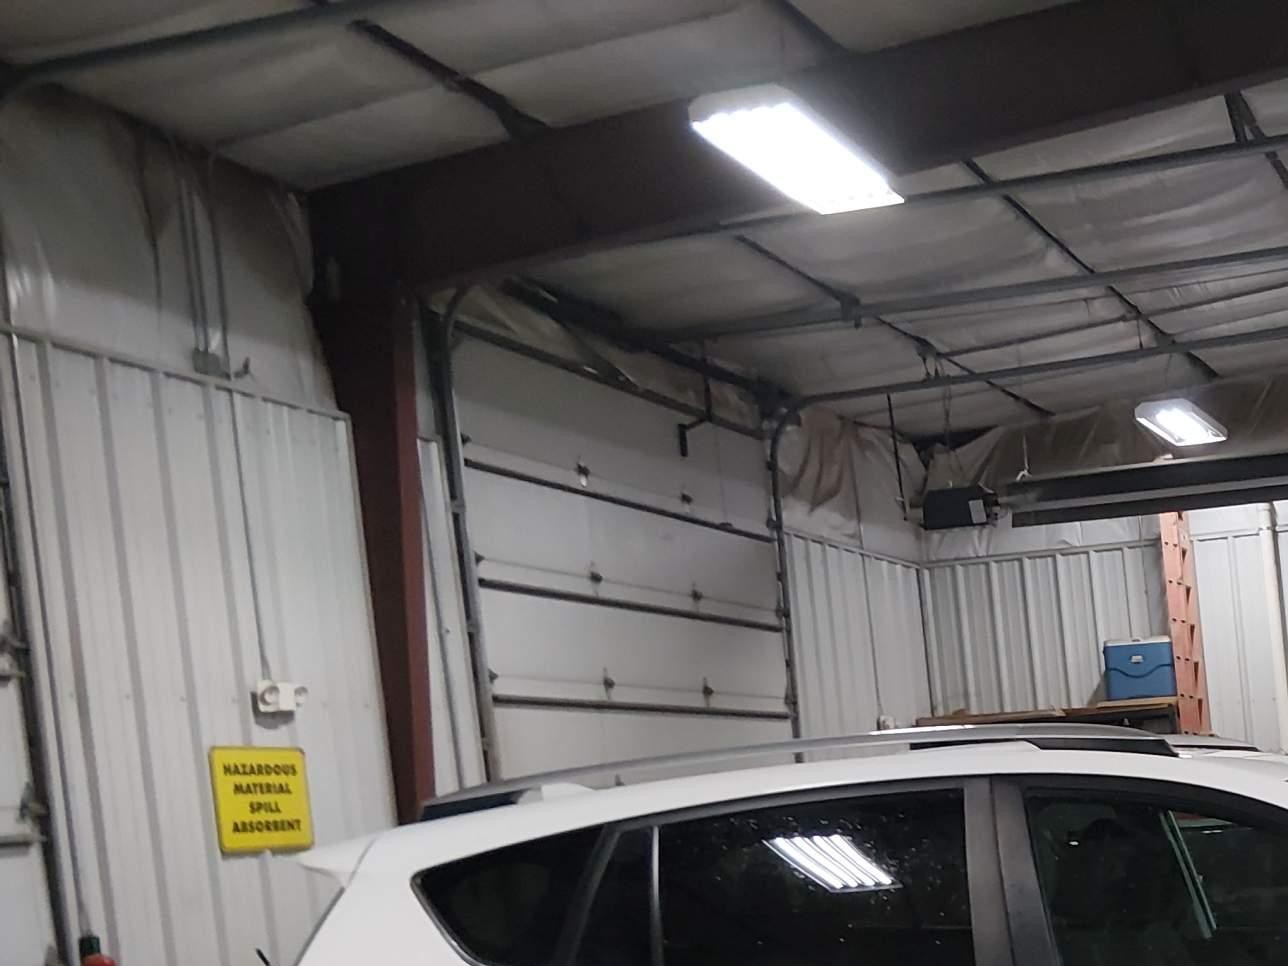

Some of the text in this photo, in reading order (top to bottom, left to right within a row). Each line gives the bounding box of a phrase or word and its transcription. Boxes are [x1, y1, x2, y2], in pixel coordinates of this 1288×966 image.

[223, 763, 297, 776] HAZARDOUS
[233, 782, 292, 795] MATERIAL
[249, 800, 282, 814] SPILL
[232, 819, 302, 833] ABSORBENT
